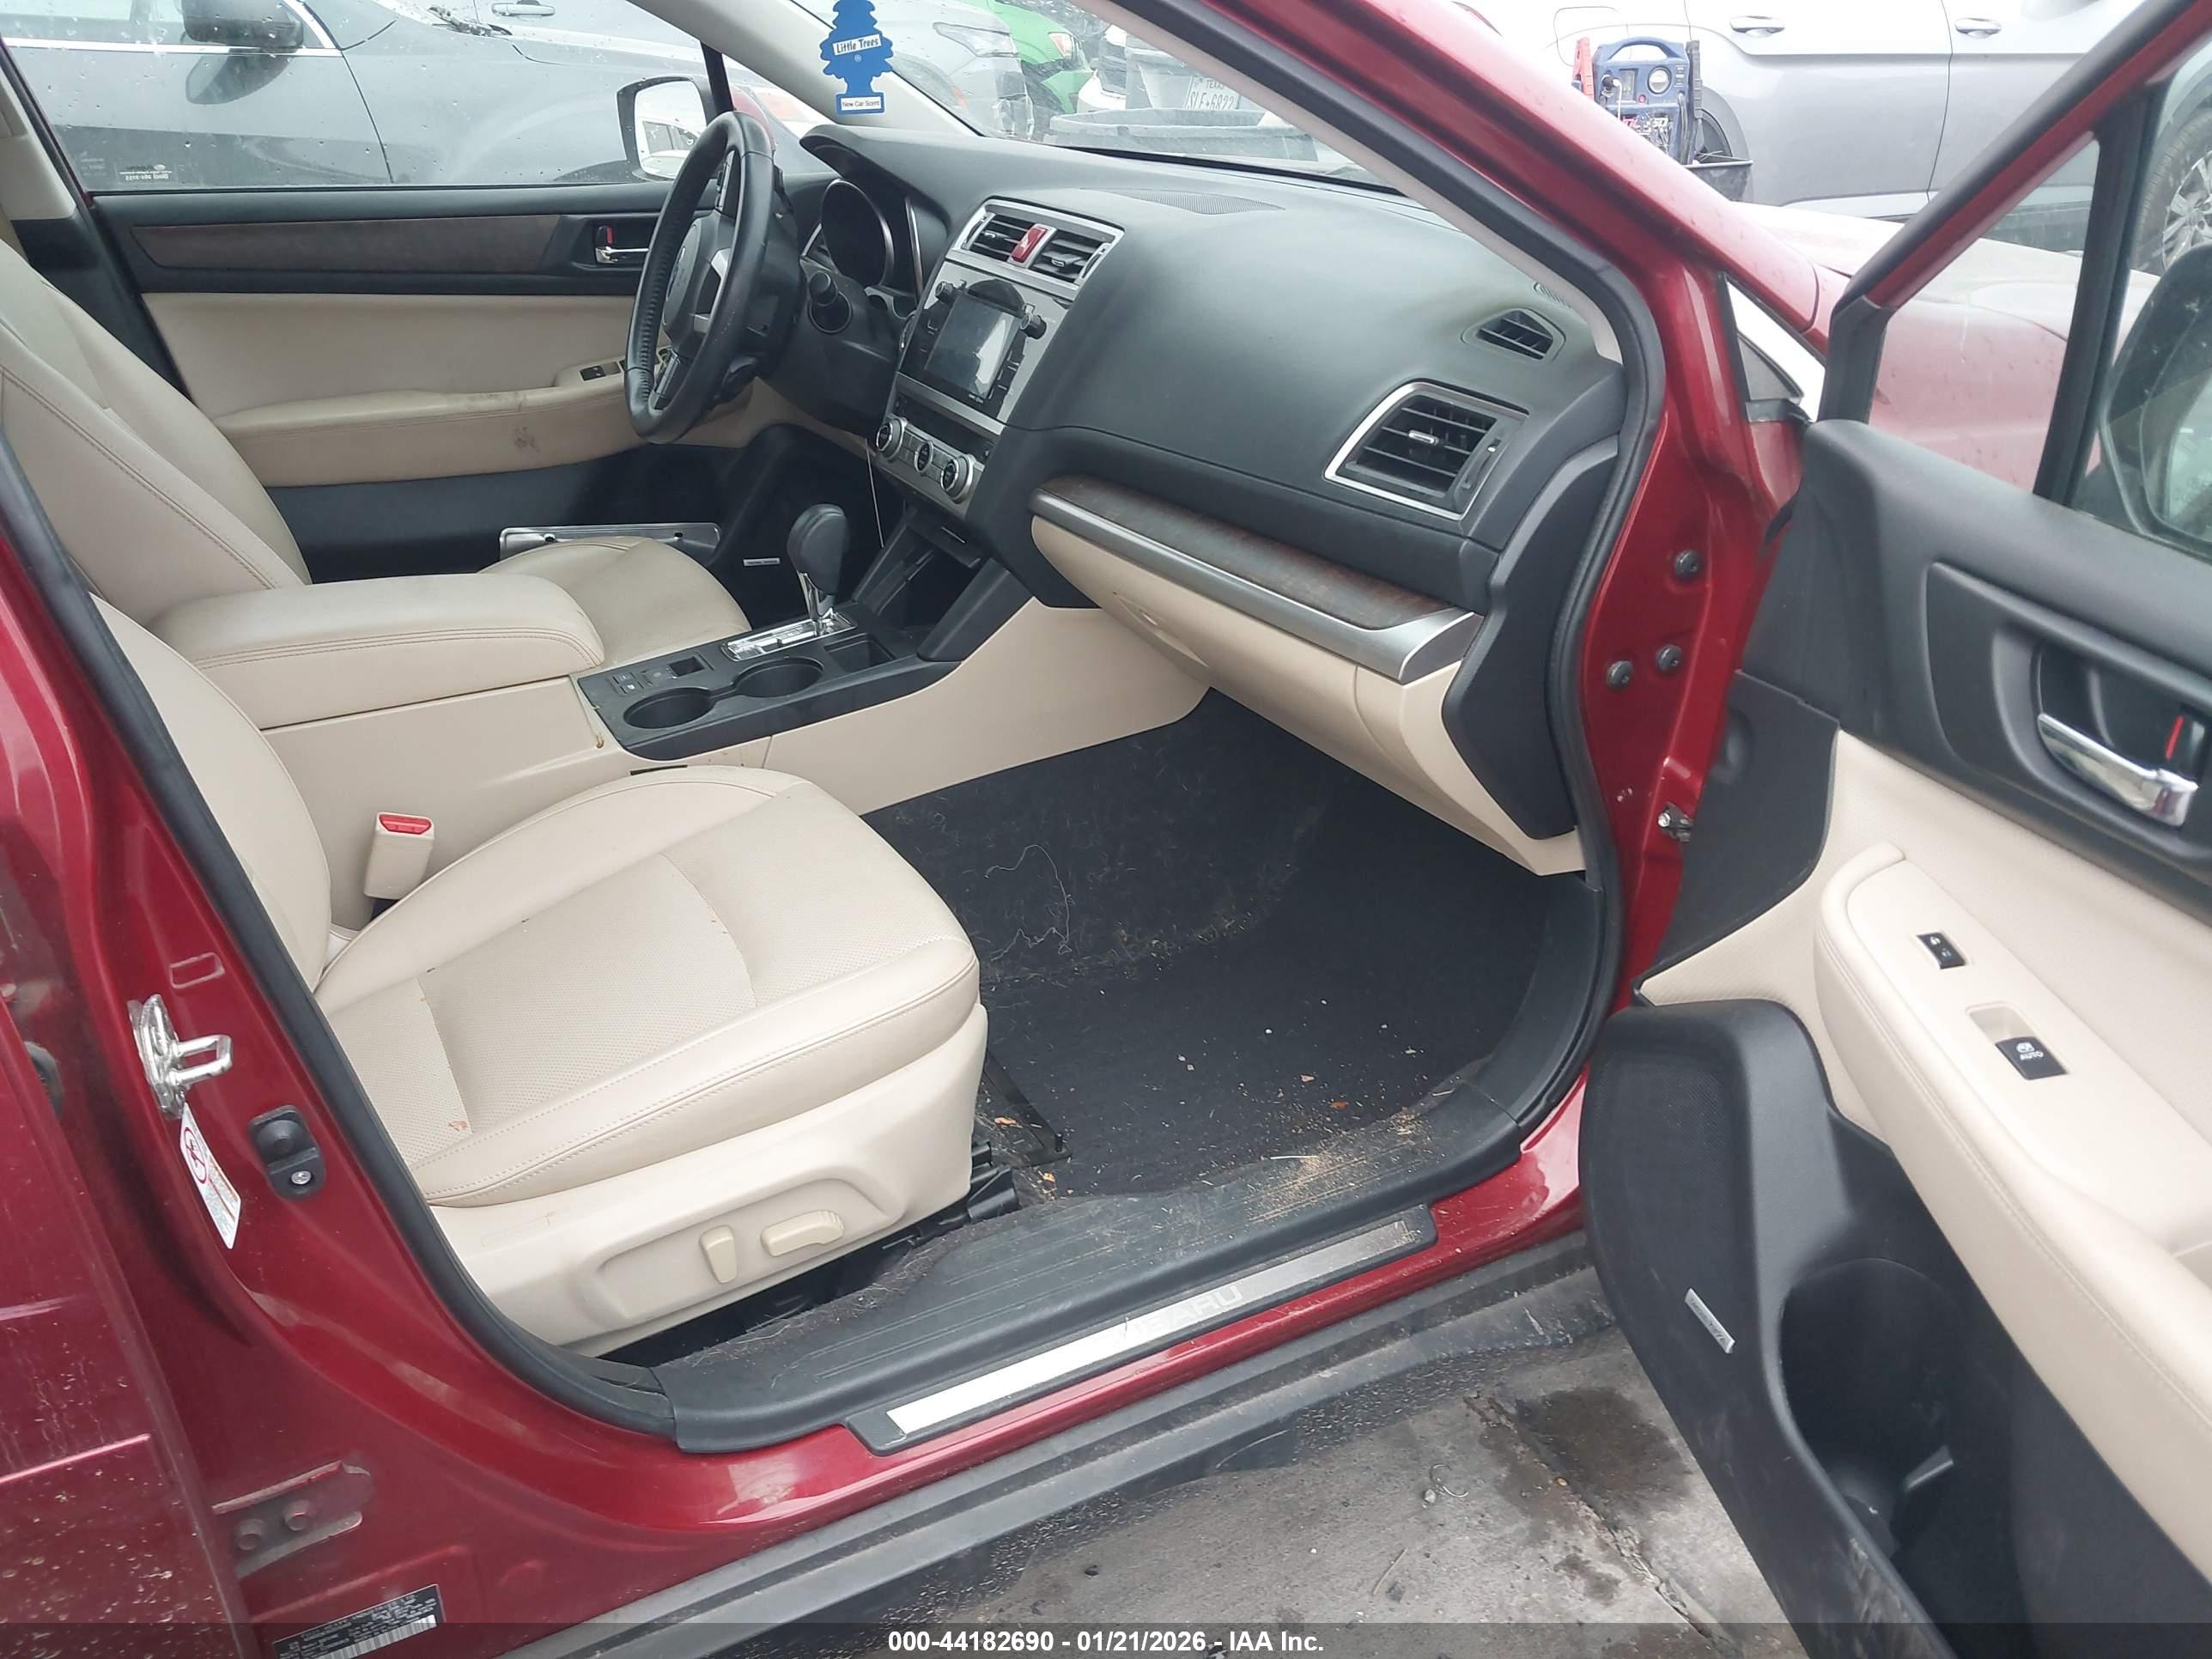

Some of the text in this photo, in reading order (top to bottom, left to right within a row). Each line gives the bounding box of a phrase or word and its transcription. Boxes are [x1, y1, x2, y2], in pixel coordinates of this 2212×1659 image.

[836, 37, 879, 53] Little Trees
[2020, 1050, 2044, 1060] AUTO
